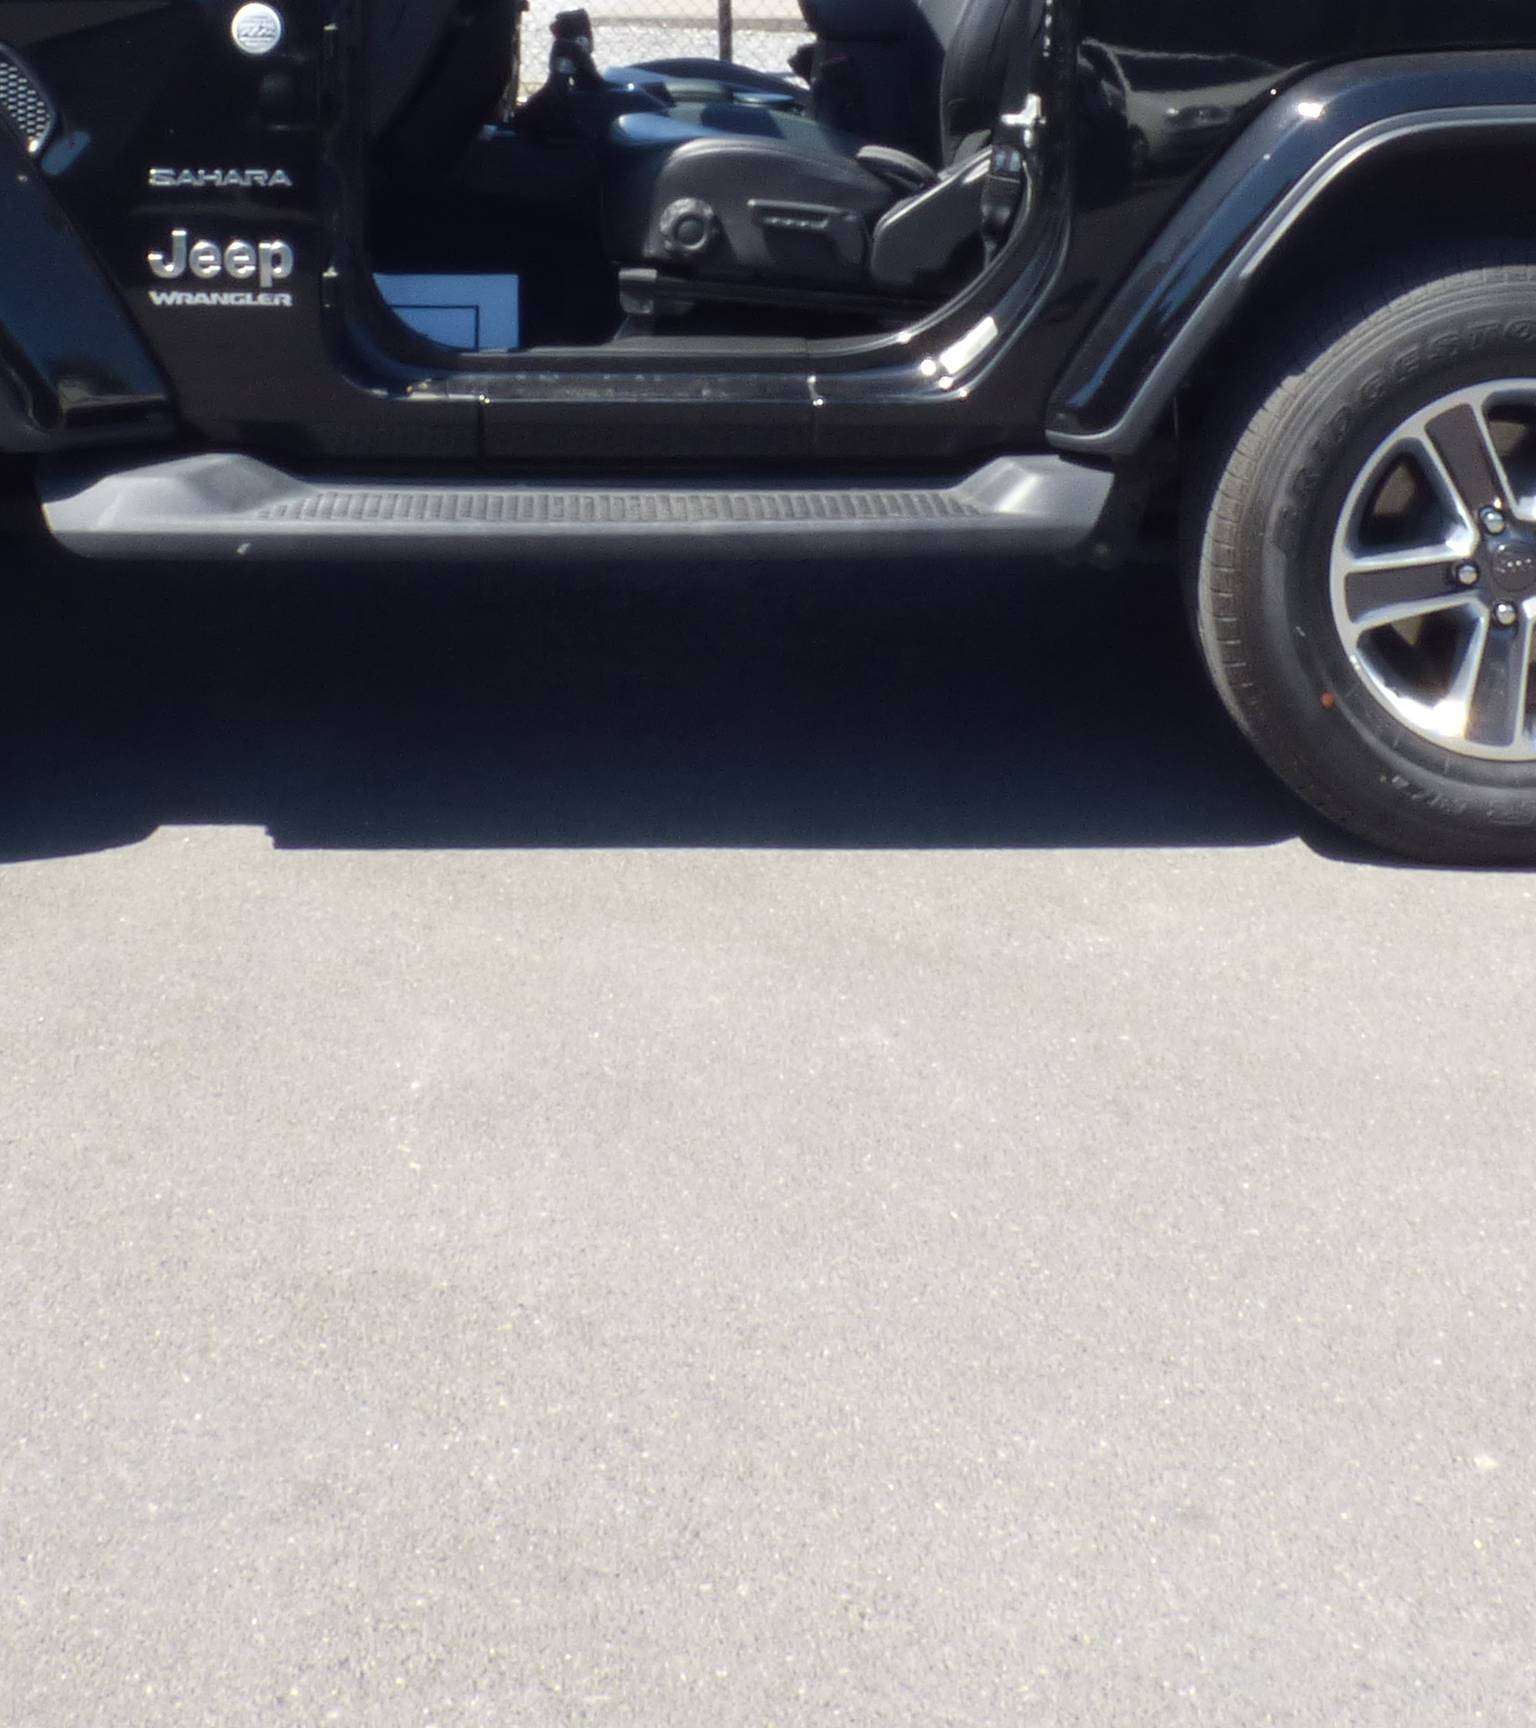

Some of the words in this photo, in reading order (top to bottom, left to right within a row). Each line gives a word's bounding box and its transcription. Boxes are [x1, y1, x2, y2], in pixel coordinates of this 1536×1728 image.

[149, 168, 293, 187] SAHARA
[148, 228, 294, 287] Jeep
[148, 290, 294, 307] WRANGLER
